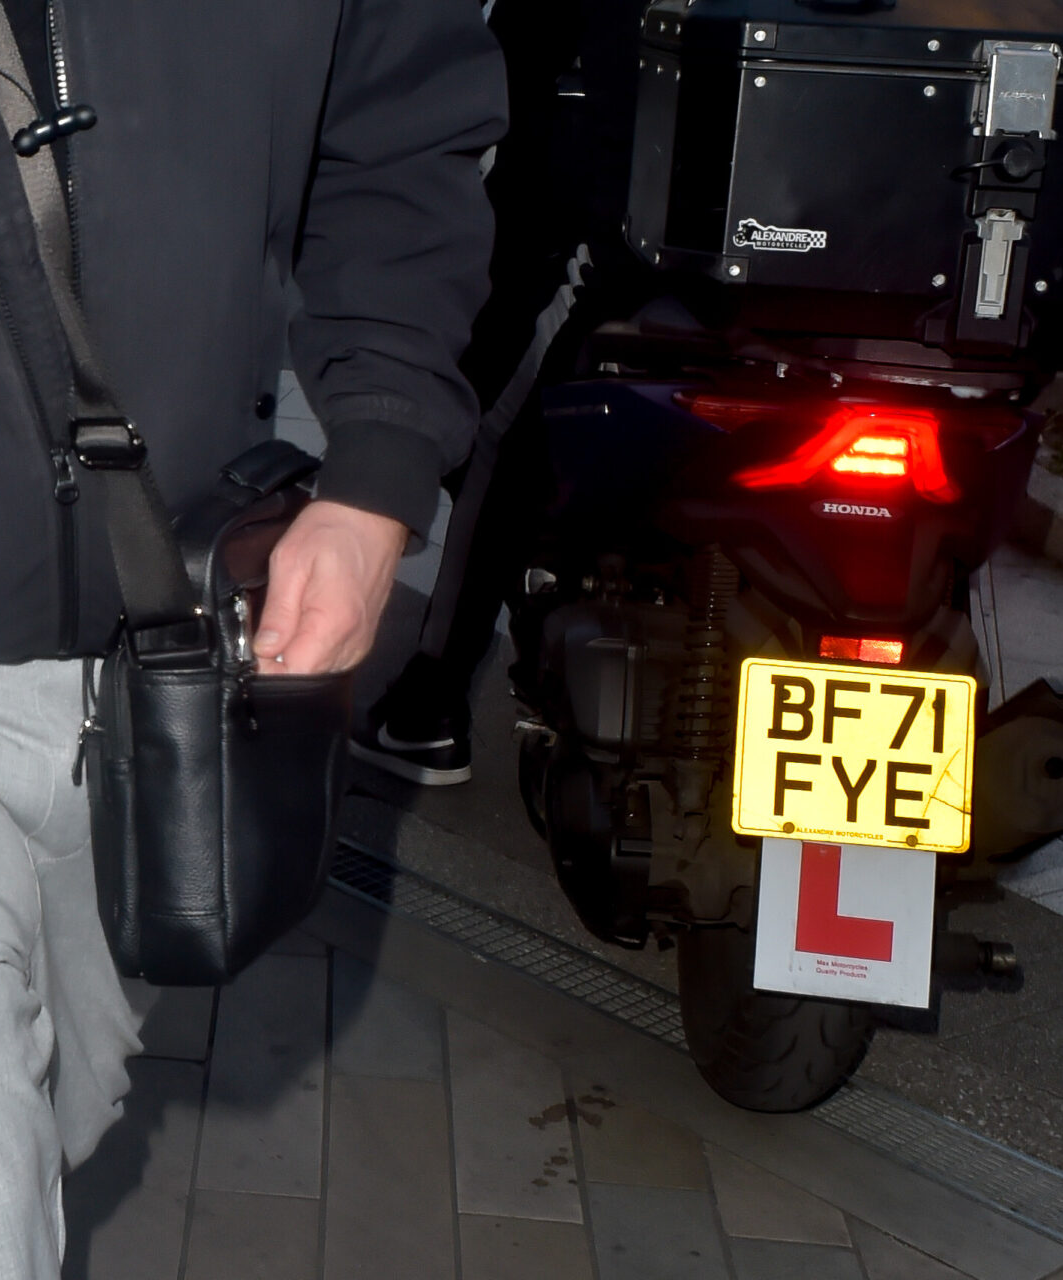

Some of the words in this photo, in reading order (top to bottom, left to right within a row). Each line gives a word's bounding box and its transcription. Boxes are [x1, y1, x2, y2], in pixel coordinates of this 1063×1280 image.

[751, 231, 808, 242] ALEXANDRE
[757, 241, 807, 249] MOTORCYCLES
[823, 502, 893, 518] HONDA
[767, 674, 946, 754] BF71
[773, 751, 933, 830] FYE
[796, 827, 834, 836] ALEXANDRE
[835, 831, 884, 840] MOTORCYCLES
[795, 841, 895, 963] L
